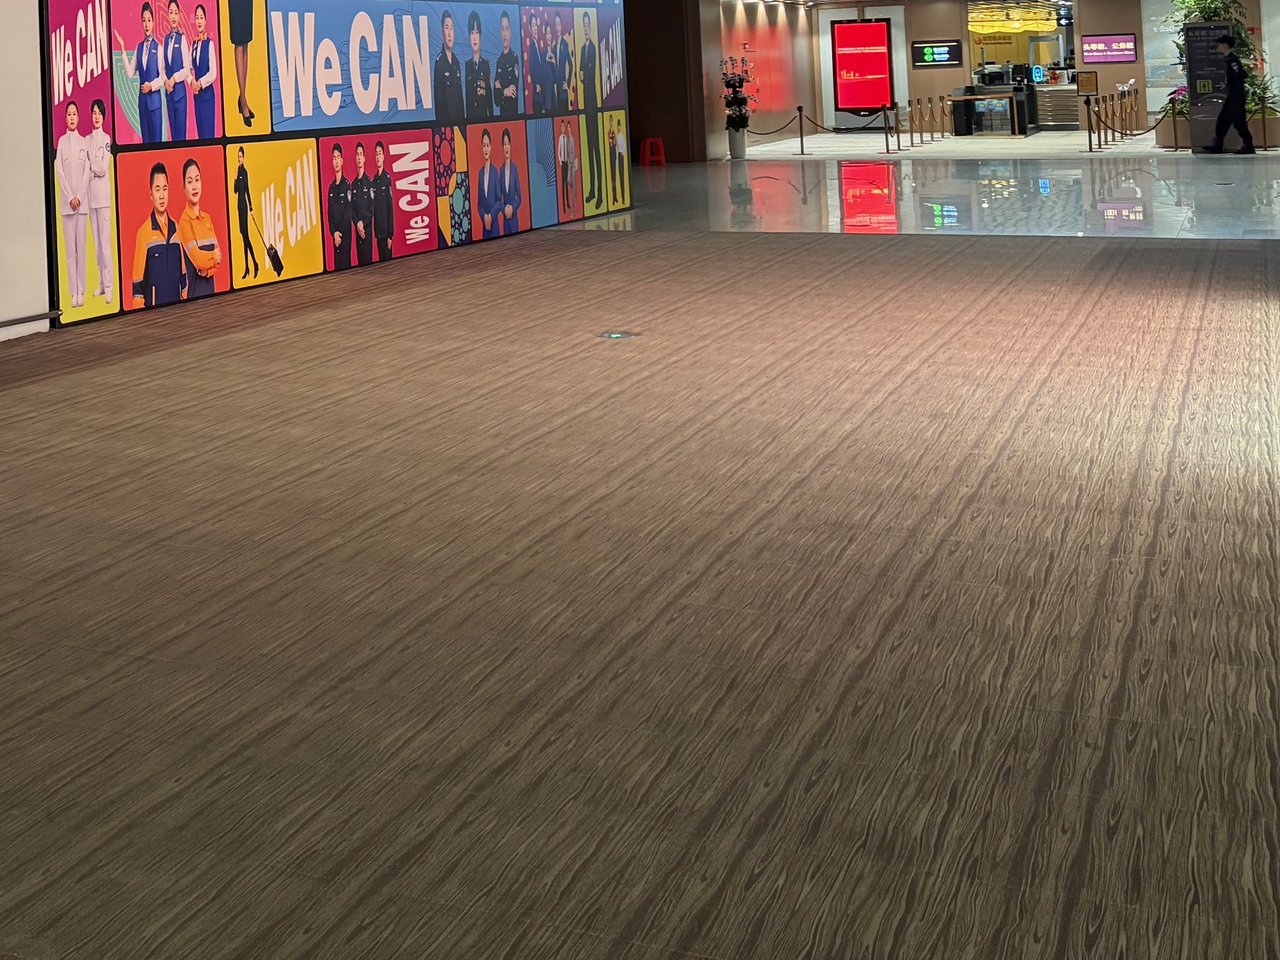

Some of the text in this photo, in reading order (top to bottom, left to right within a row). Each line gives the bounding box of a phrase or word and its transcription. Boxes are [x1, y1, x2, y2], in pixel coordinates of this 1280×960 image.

[51, 24, 74, 107] We
[270, 10, 433, 118] We CAN
[261, 148, 317, 270] We CAN
[388, 141, 430, 245] We CAN
